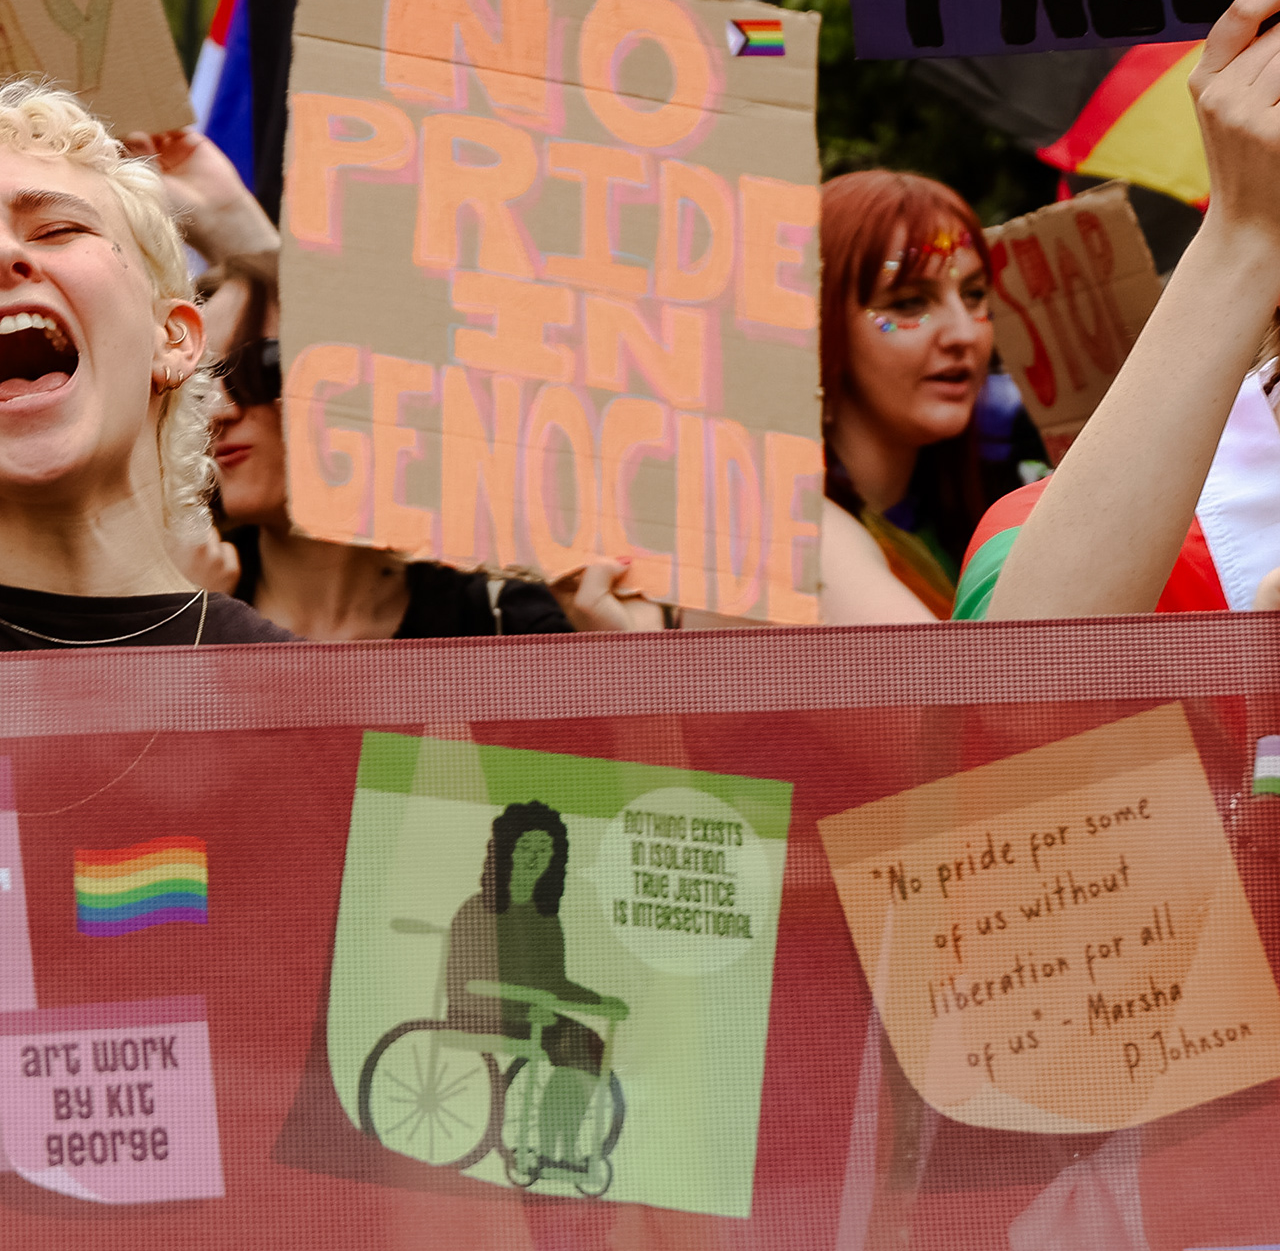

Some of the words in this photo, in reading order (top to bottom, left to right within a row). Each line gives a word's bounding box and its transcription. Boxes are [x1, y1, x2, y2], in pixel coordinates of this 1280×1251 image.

[288, 92, 821, 346] PRIDE
[449, 268, 722, 411] IN
[286, 342, 824, 626] GENOCIDE
[938, 832, 1016, 899] pride
[1030, 825, 1070, 870] for
[1085, 797, 1152, 835] some
[927, 951, 1070, 1018] liberation
[1084, 936, 1123, 983] for
[1140, 902, 1176, 946] all
[934, 923, 964, 963] of
[976, 909, 1008, 936] us
[1019, 856, 1131, 921] without
[967, 1041, 997, 1083] of
[1087, 978, 1184, 1036] Marsha
[1150, 1022, 1254, 1075] Johnson
